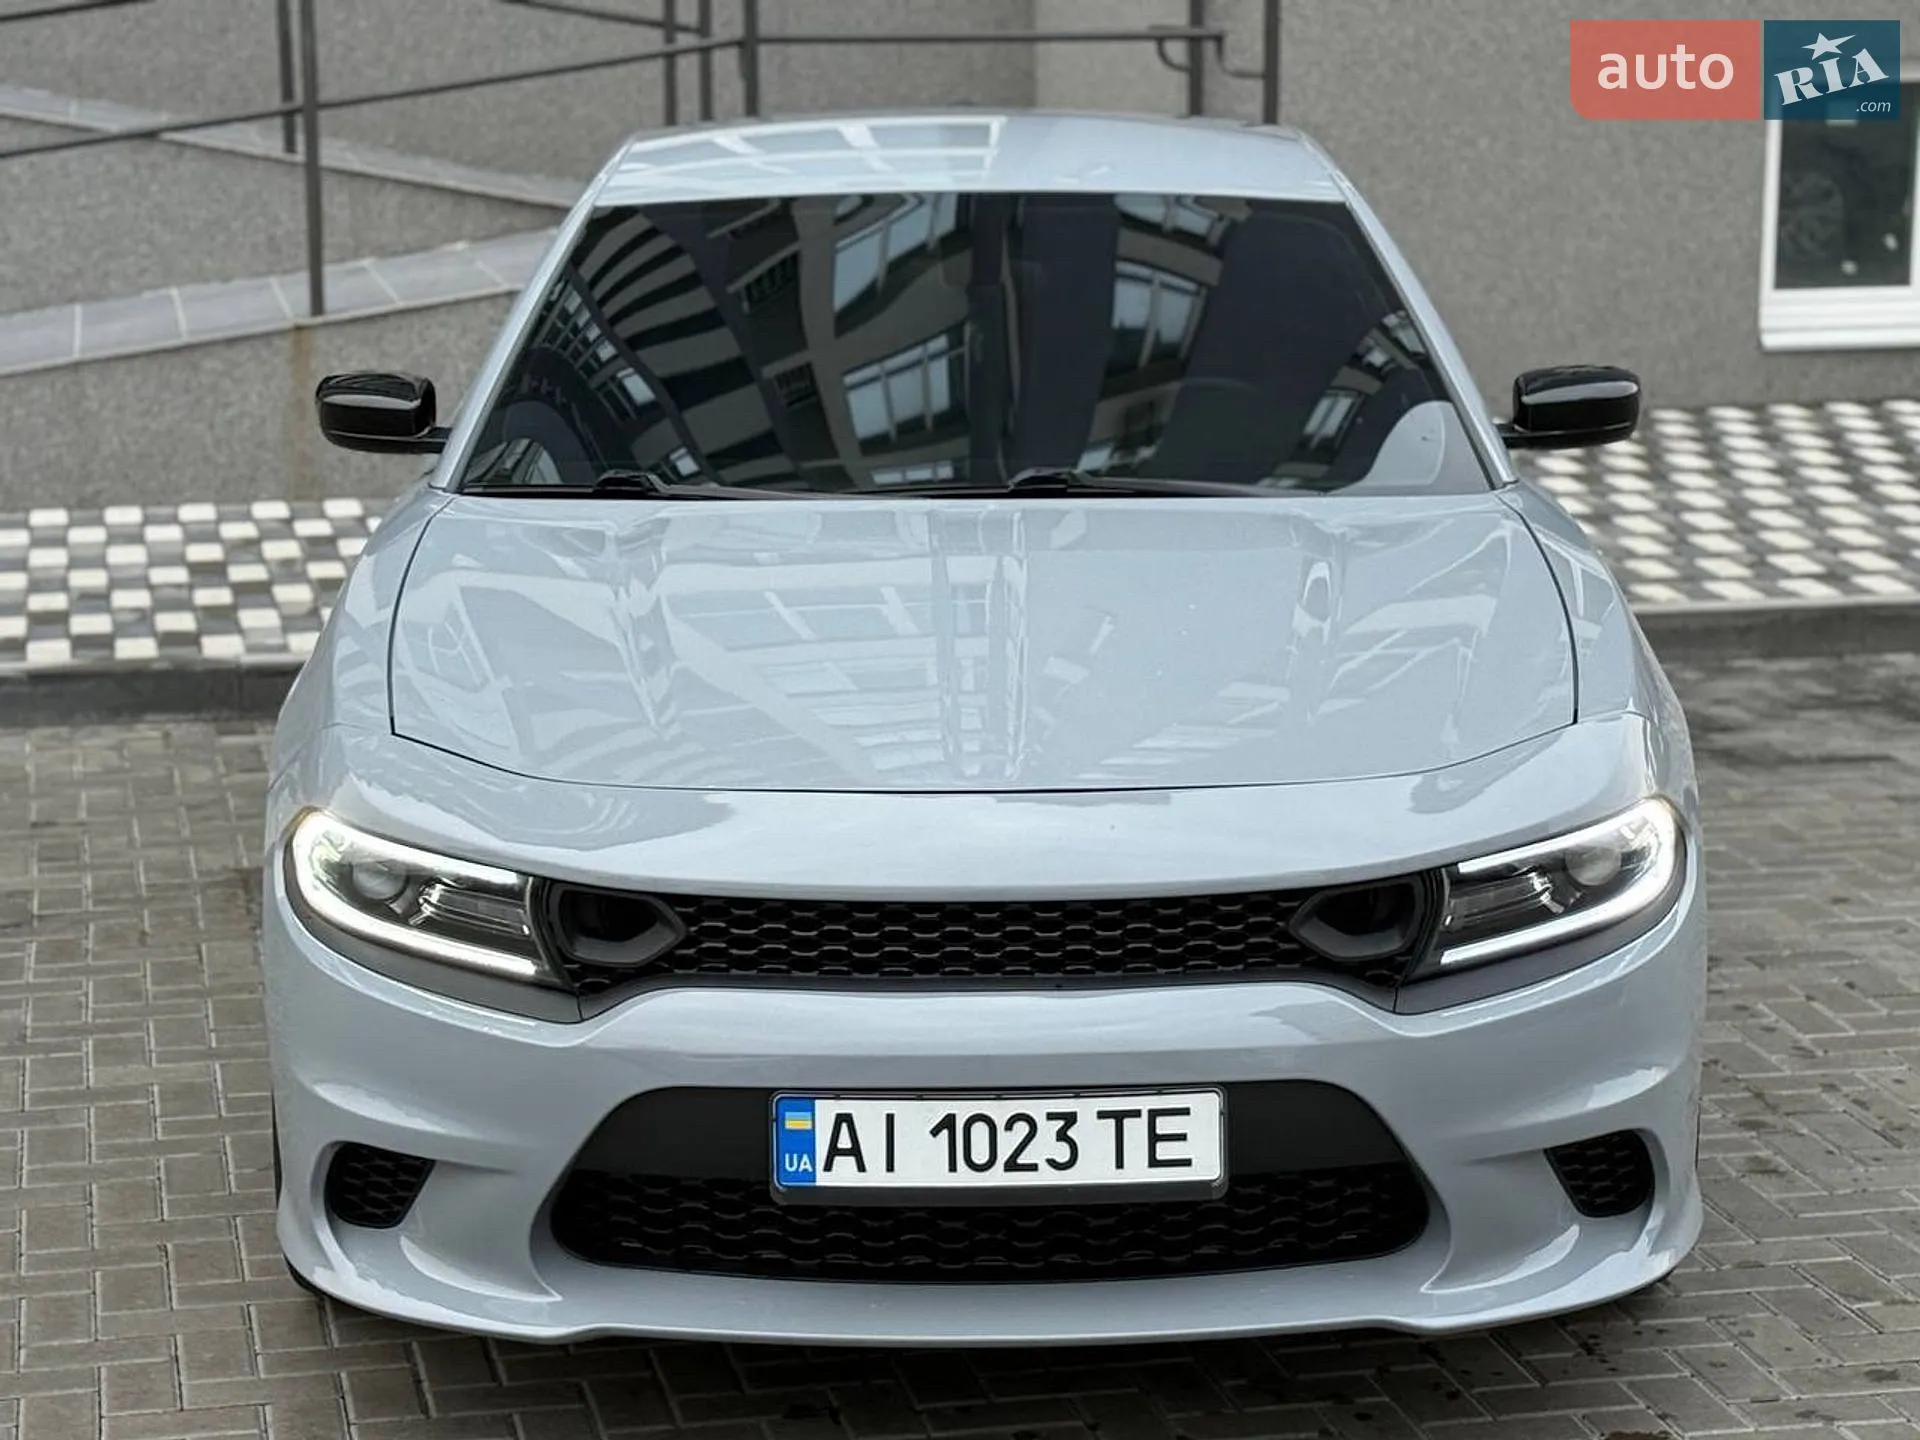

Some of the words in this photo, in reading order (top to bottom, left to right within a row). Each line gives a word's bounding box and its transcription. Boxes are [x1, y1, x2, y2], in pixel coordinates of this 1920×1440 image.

[823, 1113, 895, 1173] AI
[929, 1111, 1079, 1174] 1023
[1097, 1107, 1193, 1169] TE
[785, 1155, 813, 1172] UA
